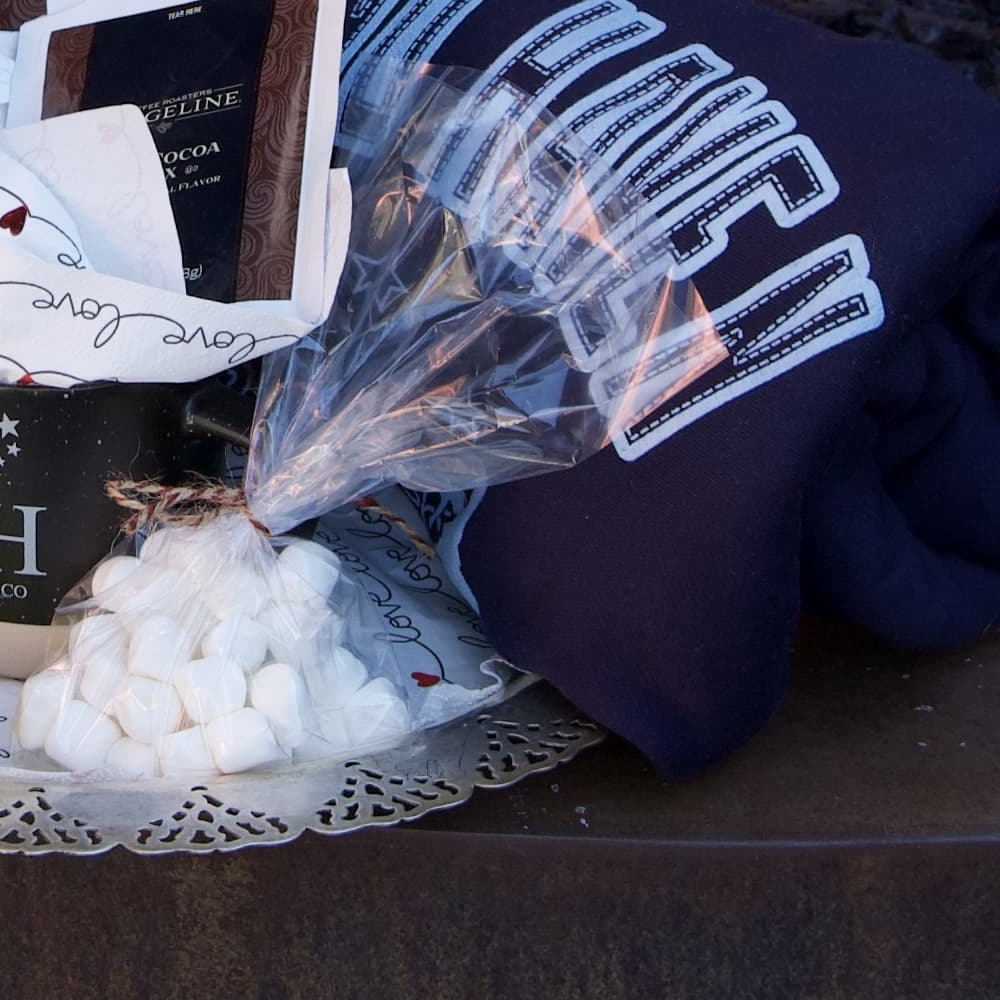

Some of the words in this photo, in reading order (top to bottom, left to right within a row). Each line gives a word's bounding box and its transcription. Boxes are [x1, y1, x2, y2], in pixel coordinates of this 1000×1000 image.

[162, 88, 212, 105] ROASTERS
[159, 141, 221, 165] OCOA
[178, 175, 221, 192] FLAVOR
[32, 291, 121, 349] love
[163, 325, 257, 365] love
[385, 547, 443, 594] love
[1, 582, 28, 600] CO
